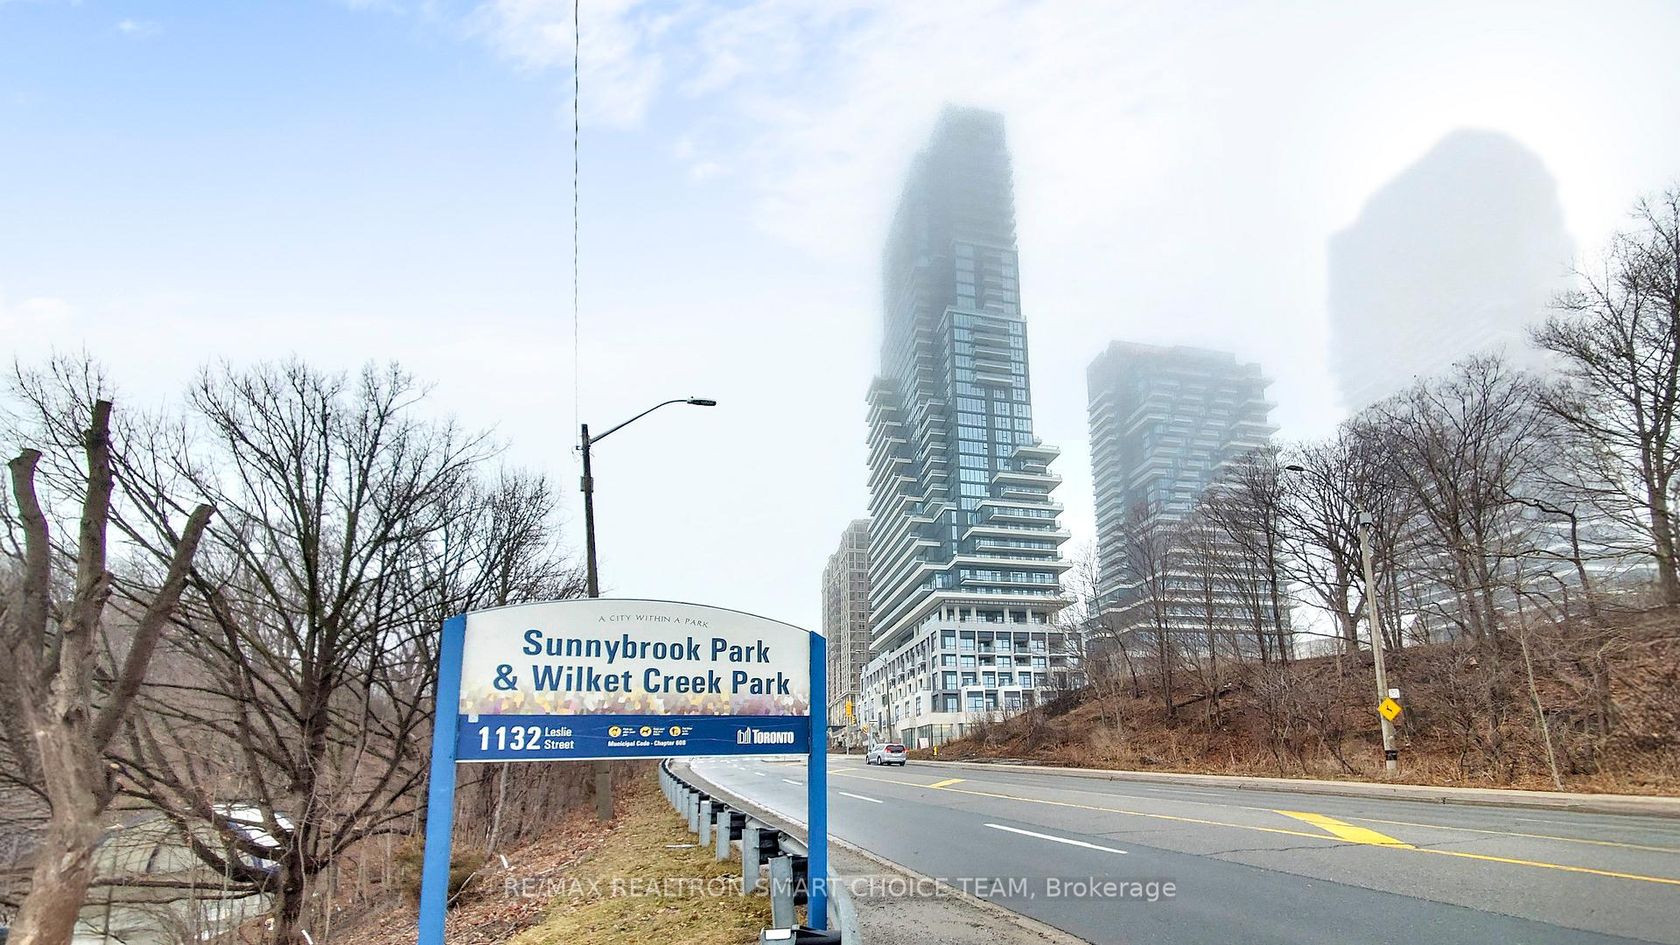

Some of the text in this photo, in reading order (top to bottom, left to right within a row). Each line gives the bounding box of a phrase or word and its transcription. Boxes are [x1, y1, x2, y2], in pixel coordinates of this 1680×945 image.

[636, 614, 671, 622] WITHIN
[684, 618, 709, 628] PARK
[522, 629, 770, 664] Sunnybrook Park
[492, 664, 790, 695] & Wilket Creek Park
[478, 726, 542, 750] 1132
[544, 726, 572, 737] Leslie
[752, 729, 794, 744] TORONTO
[544, 739, 574, 750] Street
